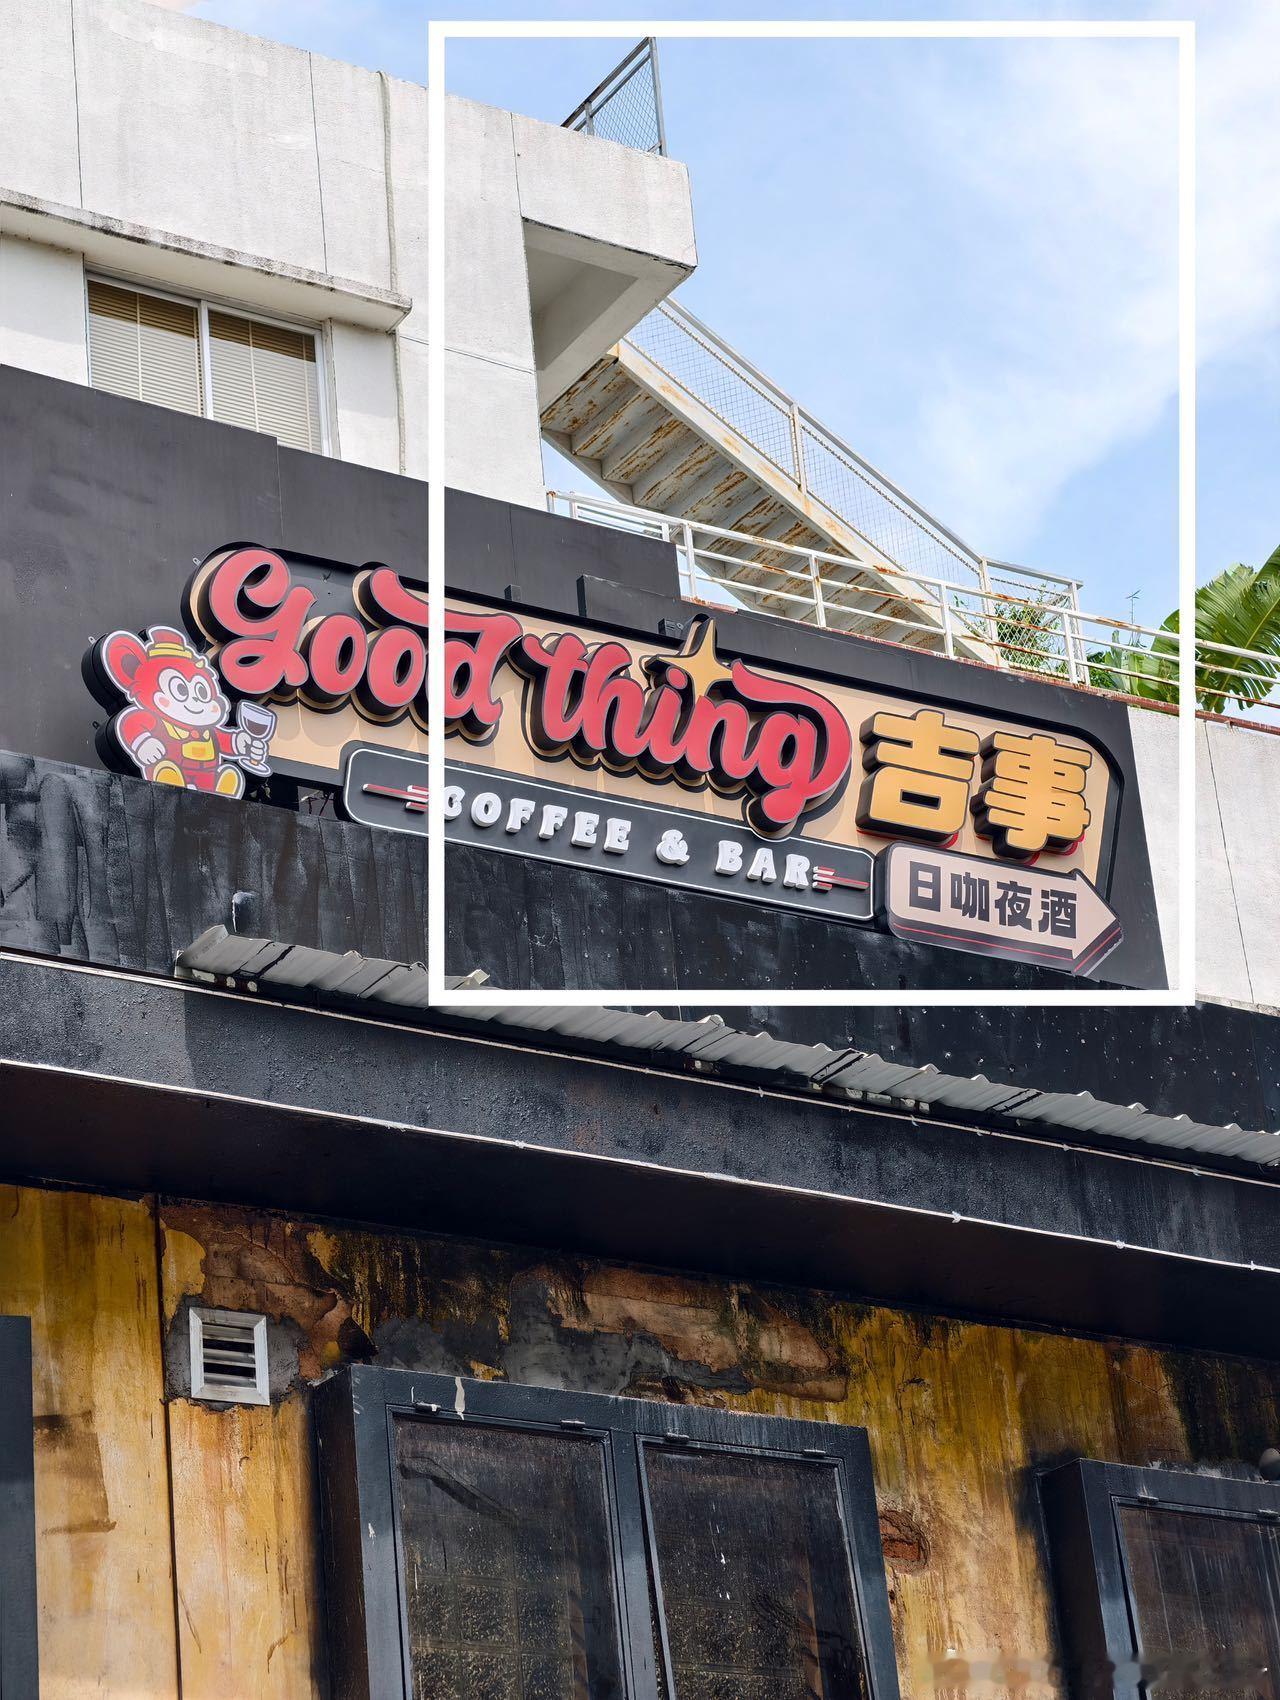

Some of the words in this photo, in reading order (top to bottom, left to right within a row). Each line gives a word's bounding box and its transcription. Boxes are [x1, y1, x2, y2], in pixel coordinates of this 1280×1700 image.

[521, 632, 852, 824] thing
[866, 709, 1093, 852] 吉事
[444, 785, 632, 854] COFFEE
[656, 829, 690, 866] &
[715, 840, 810, 890] BAR
[909, 861, 1077, 939] 日咖夜酒
